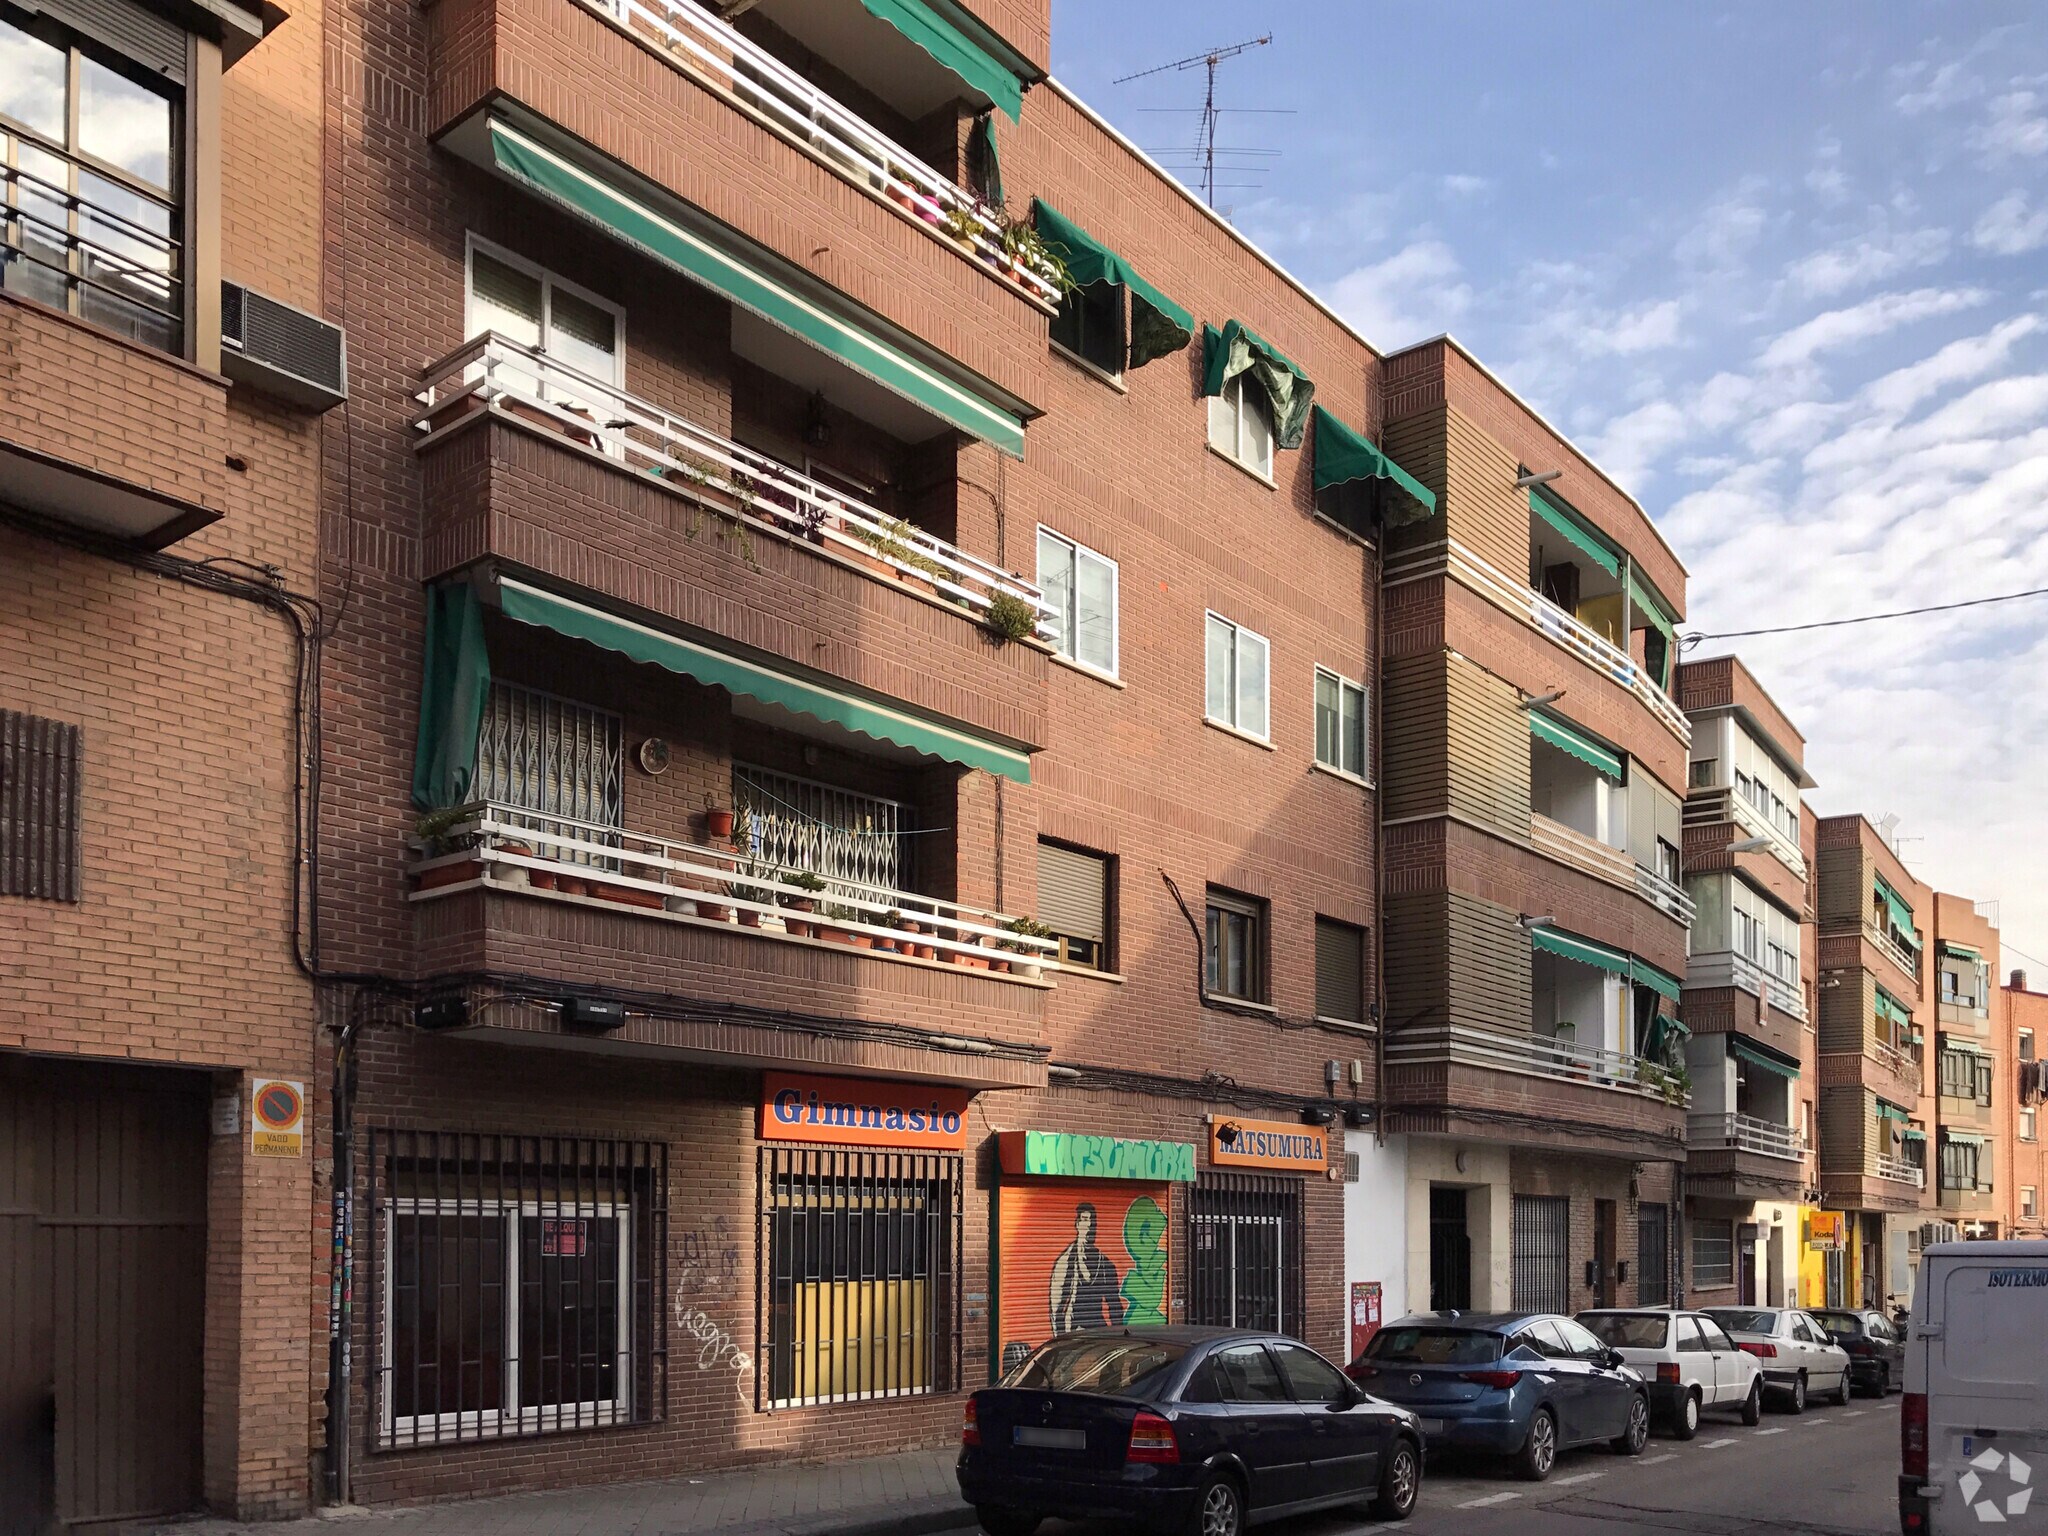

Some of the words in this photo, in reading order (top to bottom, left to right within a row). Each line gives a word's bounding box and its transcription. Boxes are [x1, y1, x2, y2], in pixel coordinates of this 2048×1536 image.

[773, 1088, 962, 1135] Gimnasio
[254, 1143, 300, 1154] PERMANENTE
[1027, 1131, 1196, 1181] MATSUMURA
[554, 1223, 585, 1233] LQUIA
